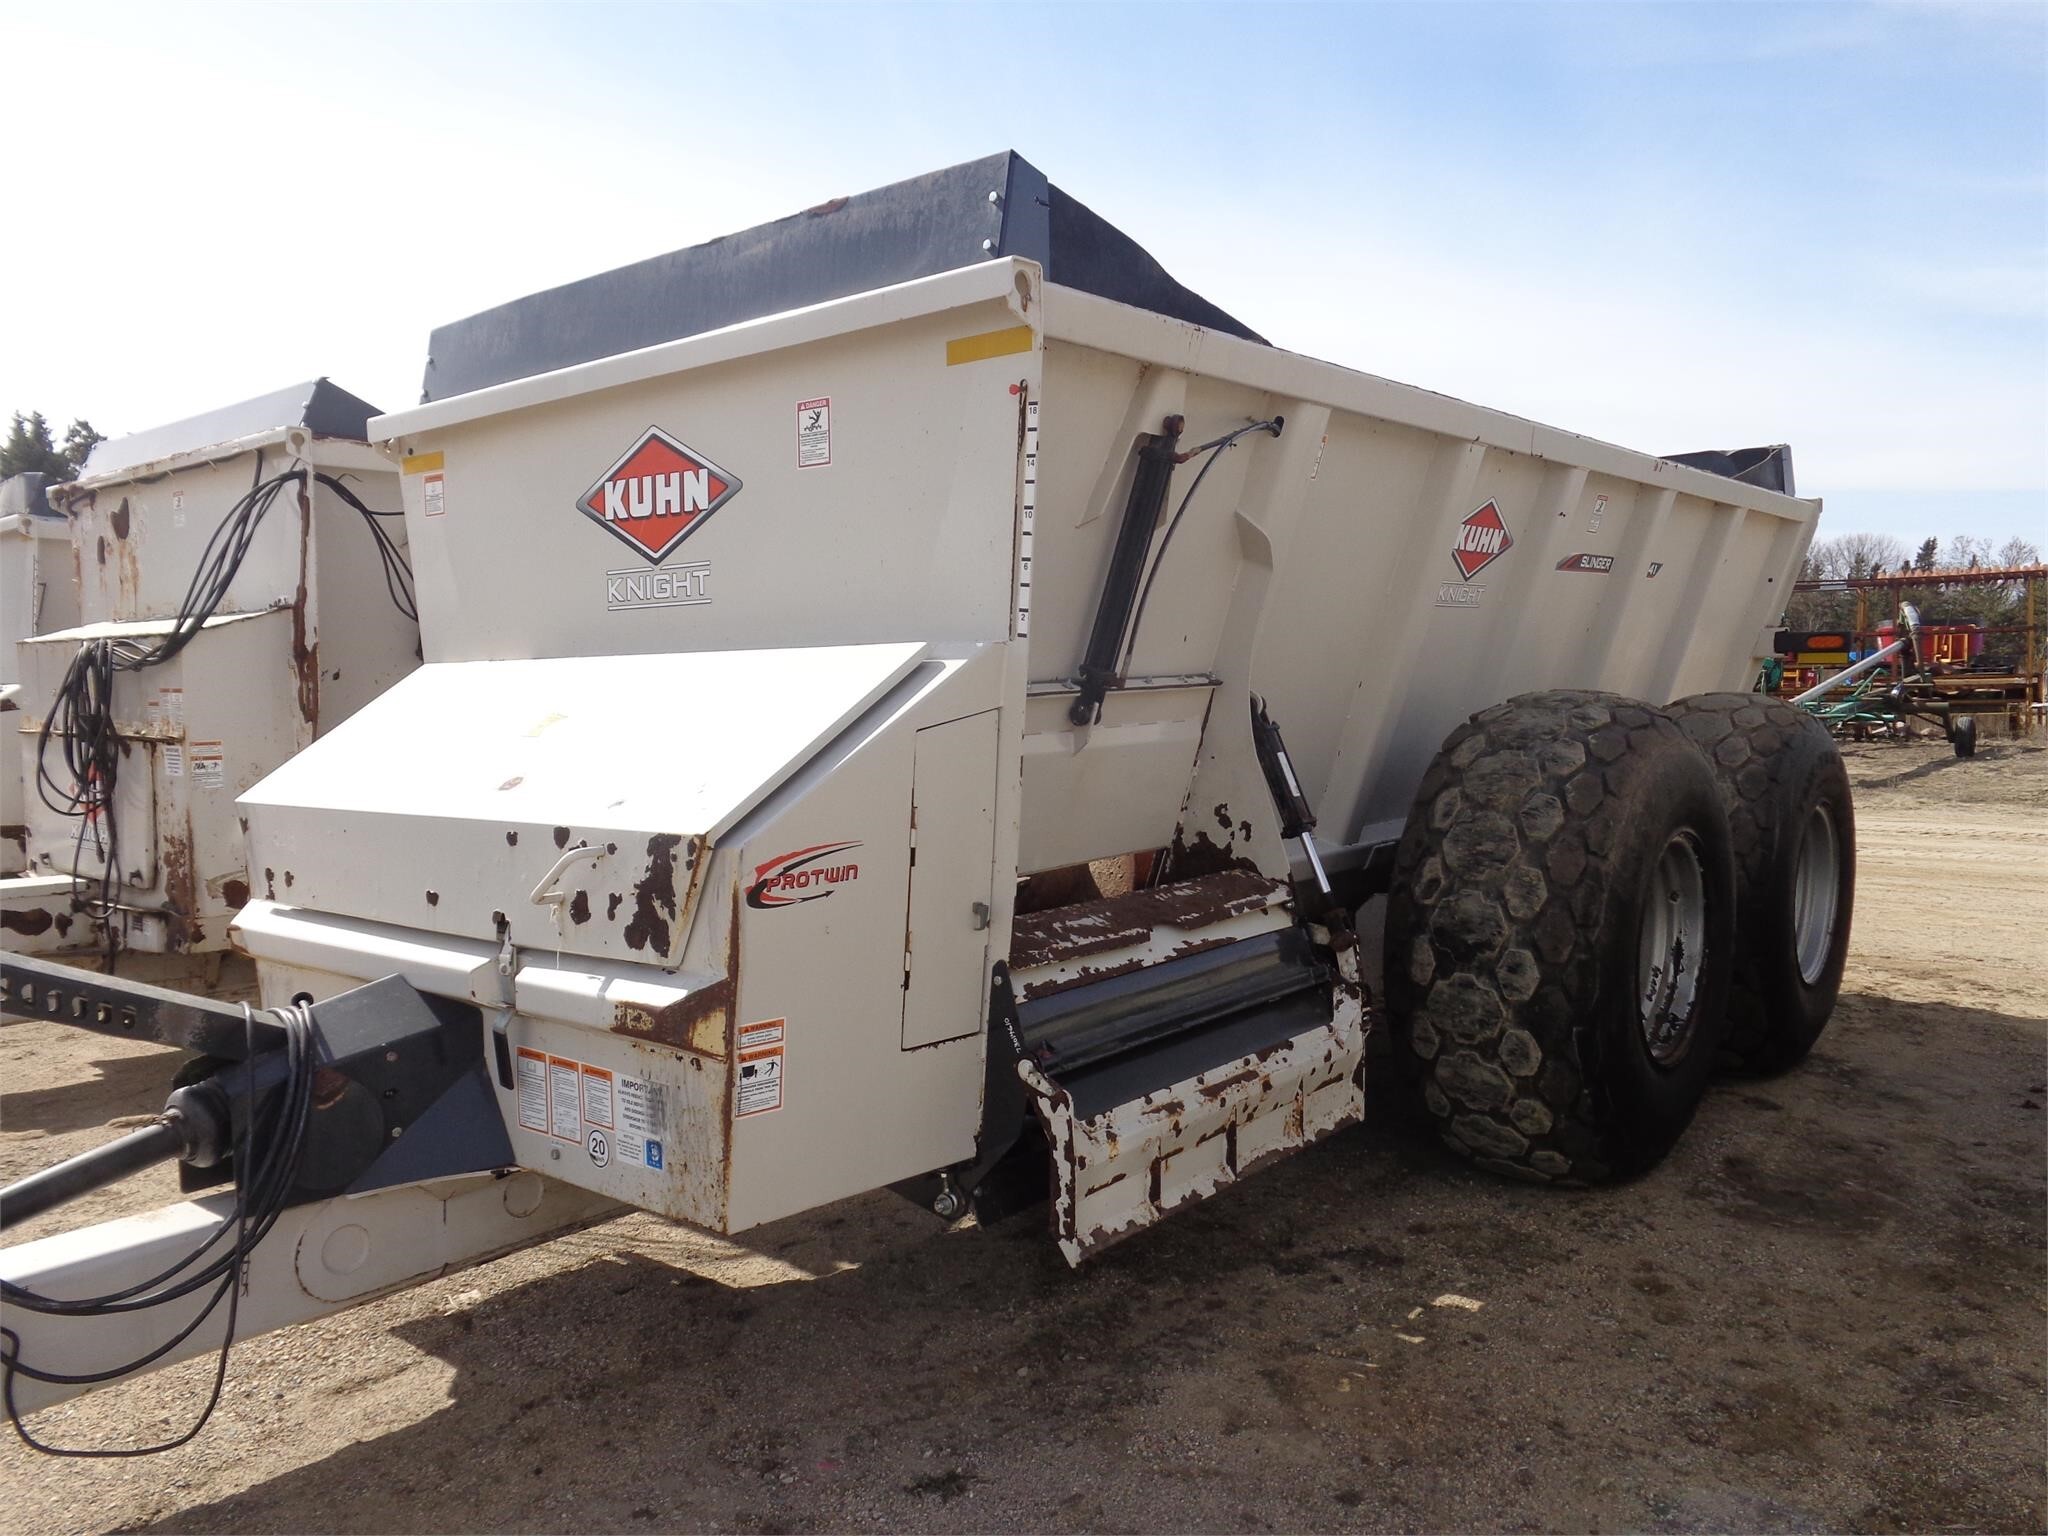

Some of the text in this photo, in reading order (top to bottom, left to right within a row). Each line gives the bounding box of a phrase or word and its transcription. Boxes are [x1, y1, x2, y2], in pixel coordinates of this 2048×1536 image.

[1028, 406, 1038, 415] 18
[1026, 459, 1036, 468] 14
[604, 467, 710, 522] KUHN
[1024, 511, 1034, 520] 10
[1454, 523, 1505, 555] KUHN
[1023, 562, 1029, 571] 6
[1580, 555, 1613, 570] SLINGER
[607, 569, 711, 603] KNIGHT
[1437, 585, 1486, 603] KNIGHT
[1020, 613, 1026, 622] 2
[766, 863, 859, 893] PROTWIN
[748, 1049, 778, 1062] WARNING
[591, 1137, 606, 1156] 20
